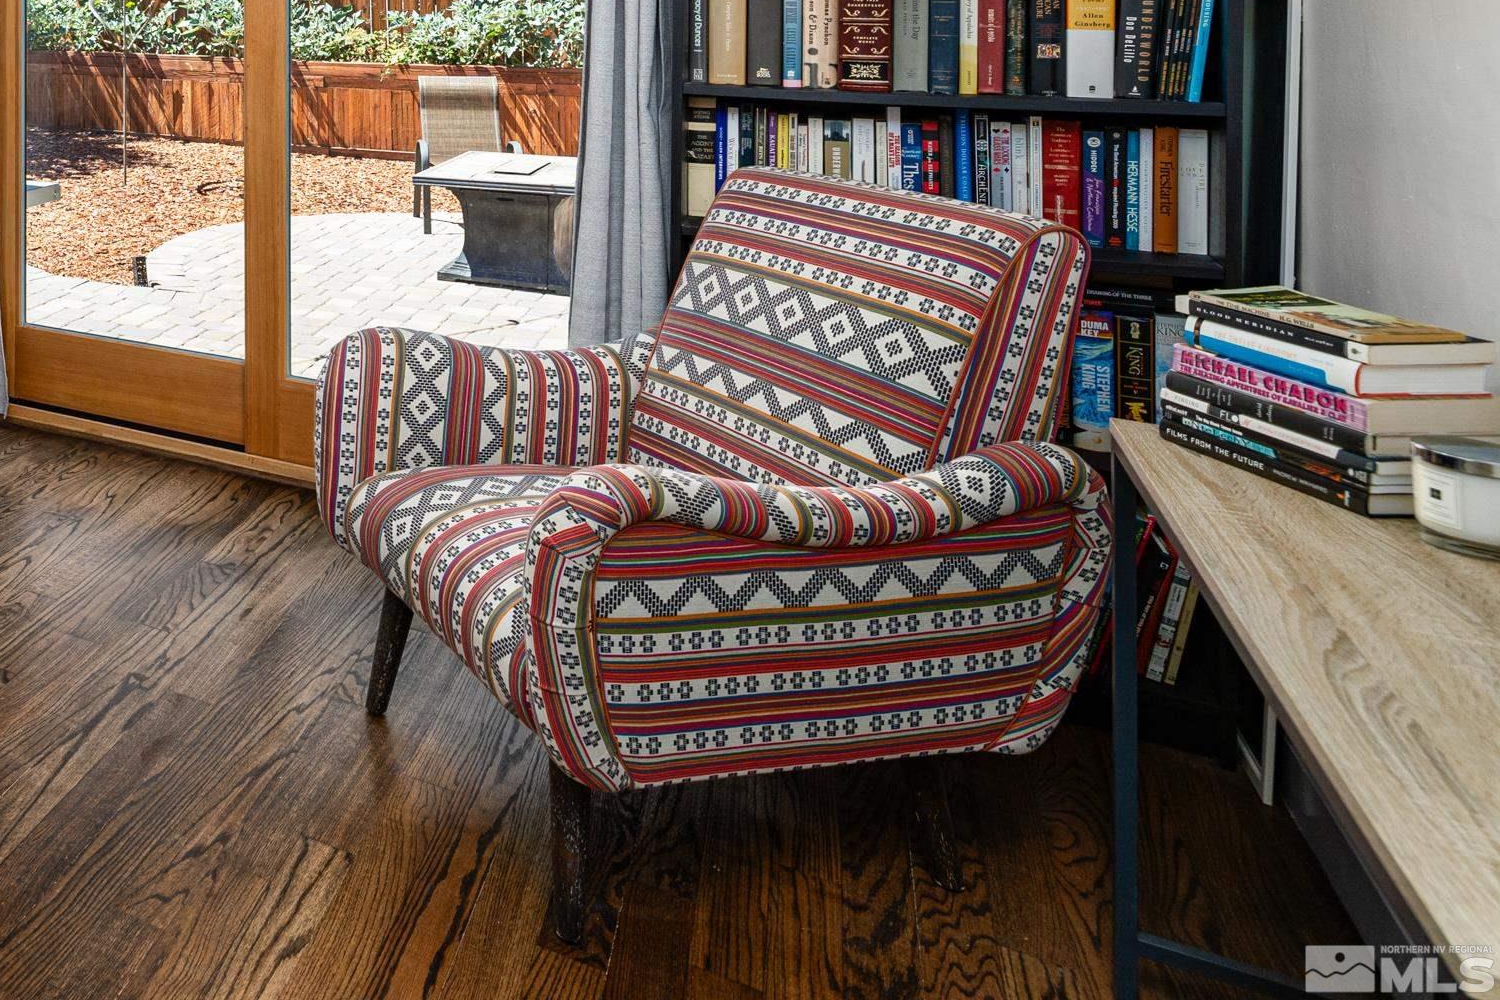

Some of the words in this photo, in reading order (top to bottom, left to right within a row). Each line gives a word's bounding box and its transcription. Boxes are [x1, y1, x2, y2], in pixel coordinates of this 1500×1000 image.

[808, 25, 816, 45] Dixon
[823, 17, 832, 46] Pynchon
[911, 26, 920, 40] Day
[1125, 16, 1137, 31] Don
[1124, 34, 1136, 63] DeLillo
[1138, 0, 1155, 82] UNDERWORLD
[993, 136, 1001, 149] GLASS
[1001, 136, 1009, 145] THE
[1014, 137, 1025, 160] blink
[993, 150, 1001, 165] WARS
[1000, 146, 1010, 165] LOOKING
[1127, 161, 1138, 204] HERMANN
[1160, 162, 1174, 216] Firestarter
[1086, 184, 1094, 207] Northern
[1086, 208, 1095, 231] California
[1127, 208, 1137, 232] HESSE
[1087, 289, 1111, 297] DRAWING
[1080, 320, 1109, 331] DUMA
[1196, 306, 1232, 321] BLOOD
[1235, 317, 1294, 337] MERIDIAN
[1226, 302, 1240, 311] TIME
[1242, 306, 1270, 318] MACHINE
[1279, 315, 1292, 324] H.G.
[1293, 318, 1315, 329] WELLS
[1080, 329, 1099, 337] KEY
[1128, 346, 1143, 376] KING
[1081, 363, 1096, 389] KING
[1180, 349, 1258, 386] MICHAEL
[1263, 374, 1349, 414] CHABON
[1096, 365, 1111, 412] STEPHEN
[1180, 364, 1191, 373] THE
[1192, 367, 1226, 385] AMAZING
[1226, 377, 1270, 399] ADVENTURES
[1270, 393, 1282, 402] OF
[1283, 396, 1319, 414] KAVALIER
[1328, 409, 1348, 421] CLAY
[1166, 427, 1188, 441] FILMS
[1190, 436, 1212, 451] FROM
[1214, 445, 1229, 457] THE
[1232, 453, 1265, 471] FUTURE
